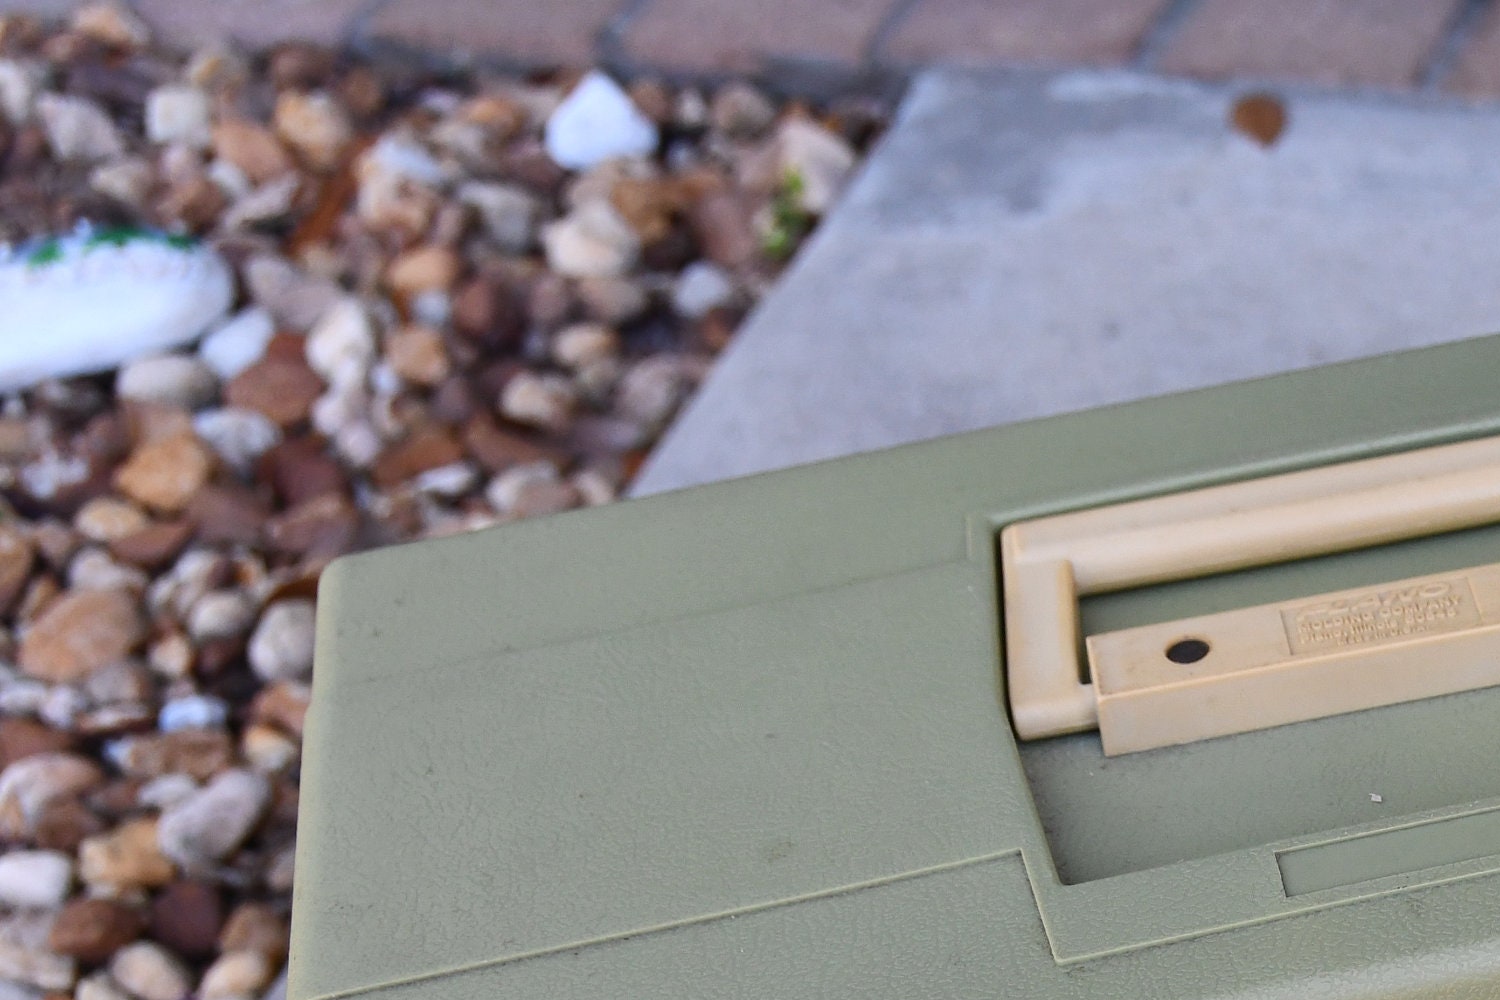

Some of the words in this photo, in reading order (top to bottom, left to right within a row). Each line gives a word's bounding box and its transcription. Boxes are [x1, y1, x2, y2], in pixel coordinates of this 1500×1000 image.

[1299, 612, 1374, 633] MOLDING
[1379, 595, 1461, 618] COMPANY
[1350, 616, 1397, 635] Illinois
